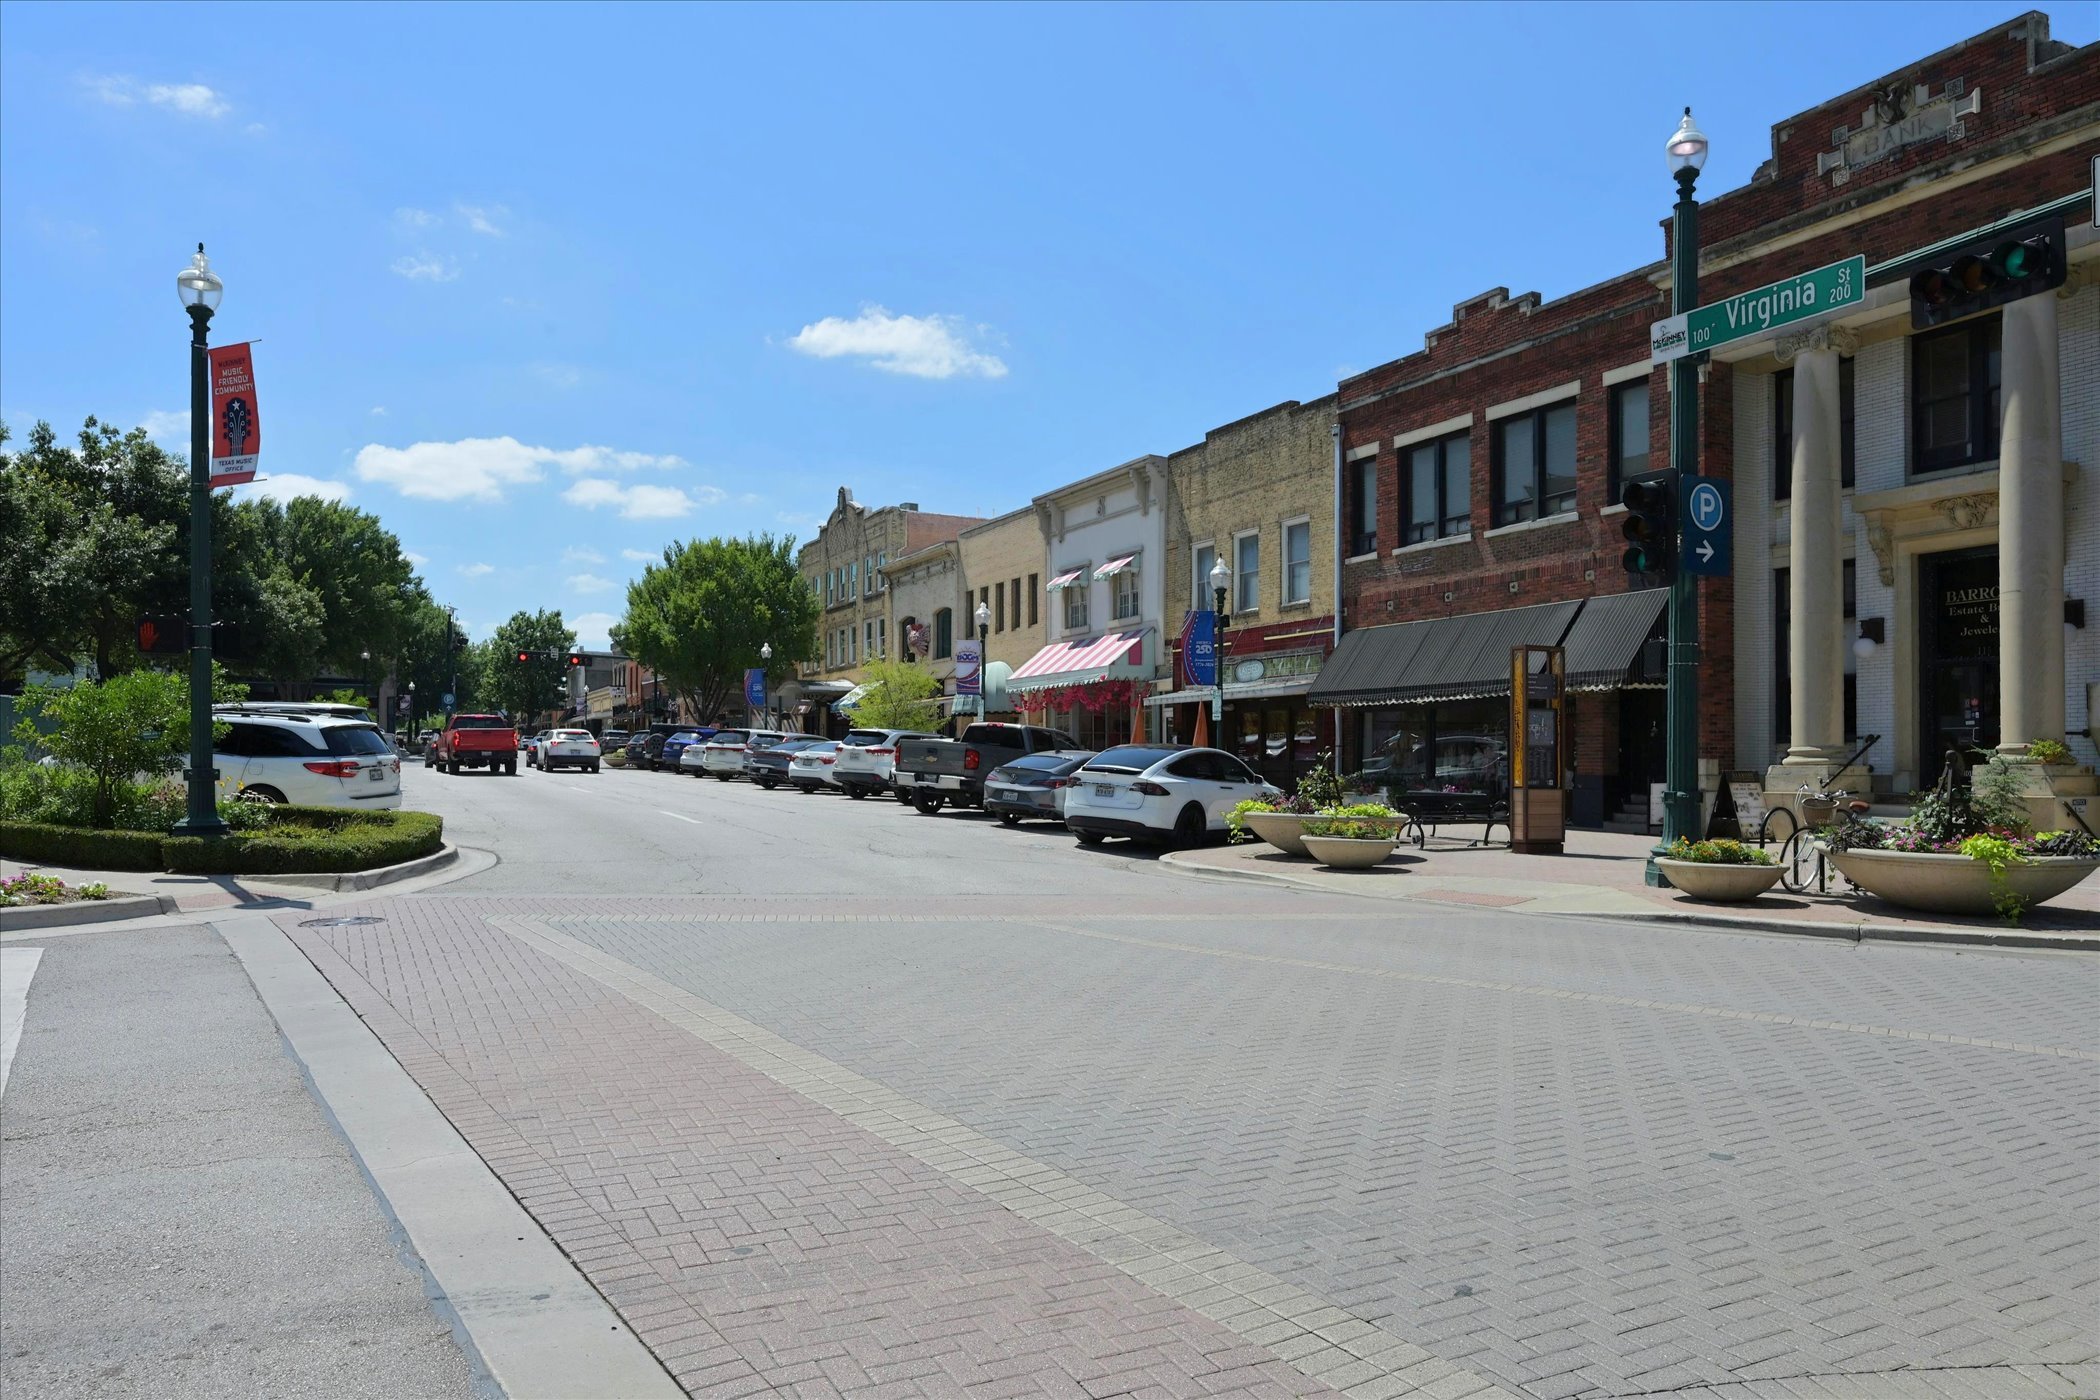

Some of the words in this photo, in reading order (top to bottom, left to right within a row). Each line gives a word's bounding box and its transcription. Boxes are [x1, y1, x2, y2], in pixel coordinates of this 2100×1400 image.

[1863, 117, 1933, 155] BANK
[1838, 267, 1850, 283] St
[1693, 327, 1710, 344] 100
[1725, 278, 1815, 328] Virginia
[1830, 285, 1851, 303] 200
[222, 367, 243, 376] MUSIC
[218, 375, 248, 386] FRIENDLY
[215, 383, 253, 395] COMMUNITY
[1700, 493, 1715, 521] P
[1949, 606, 1984, 616] Estate
[1980, 613, 1989, 623] &
[1195, 645, 1213, 654] 250
